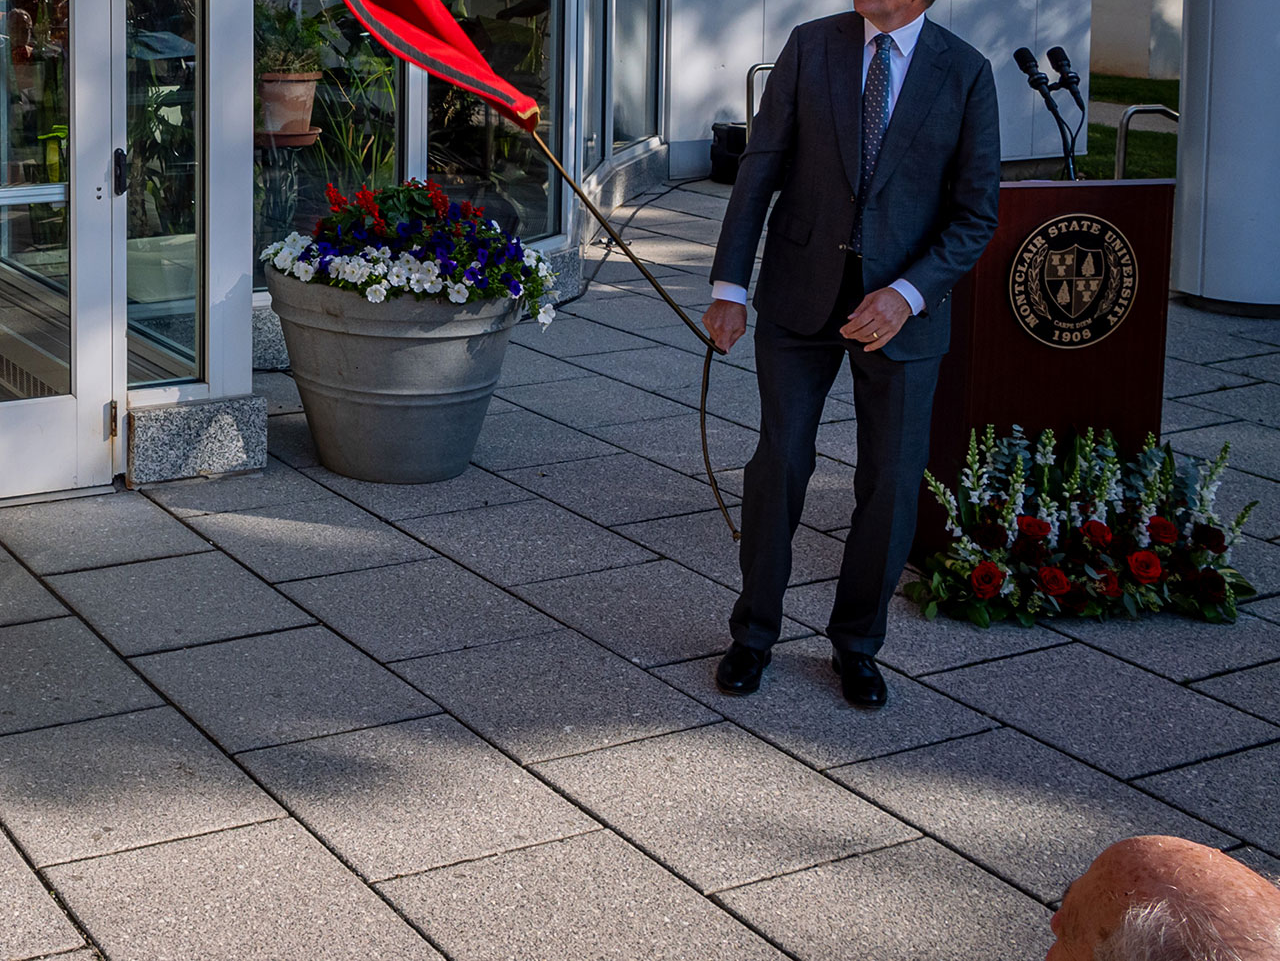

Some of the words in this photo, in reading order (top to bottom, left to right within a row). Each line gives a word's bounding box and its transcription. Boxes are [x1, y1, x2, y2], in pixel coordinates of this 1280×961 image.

[1014, 235, 1046, 329] MONTCLAIR
[1048, 220, 1102, 238] STATE
[1104, 230, 1134, 327] UNIVERSITY
[1053, 319, 1075, 329] CARPE
[1075, 317, 1093, 329] DIEM
[1052, 328, 1092, 342] 1908
